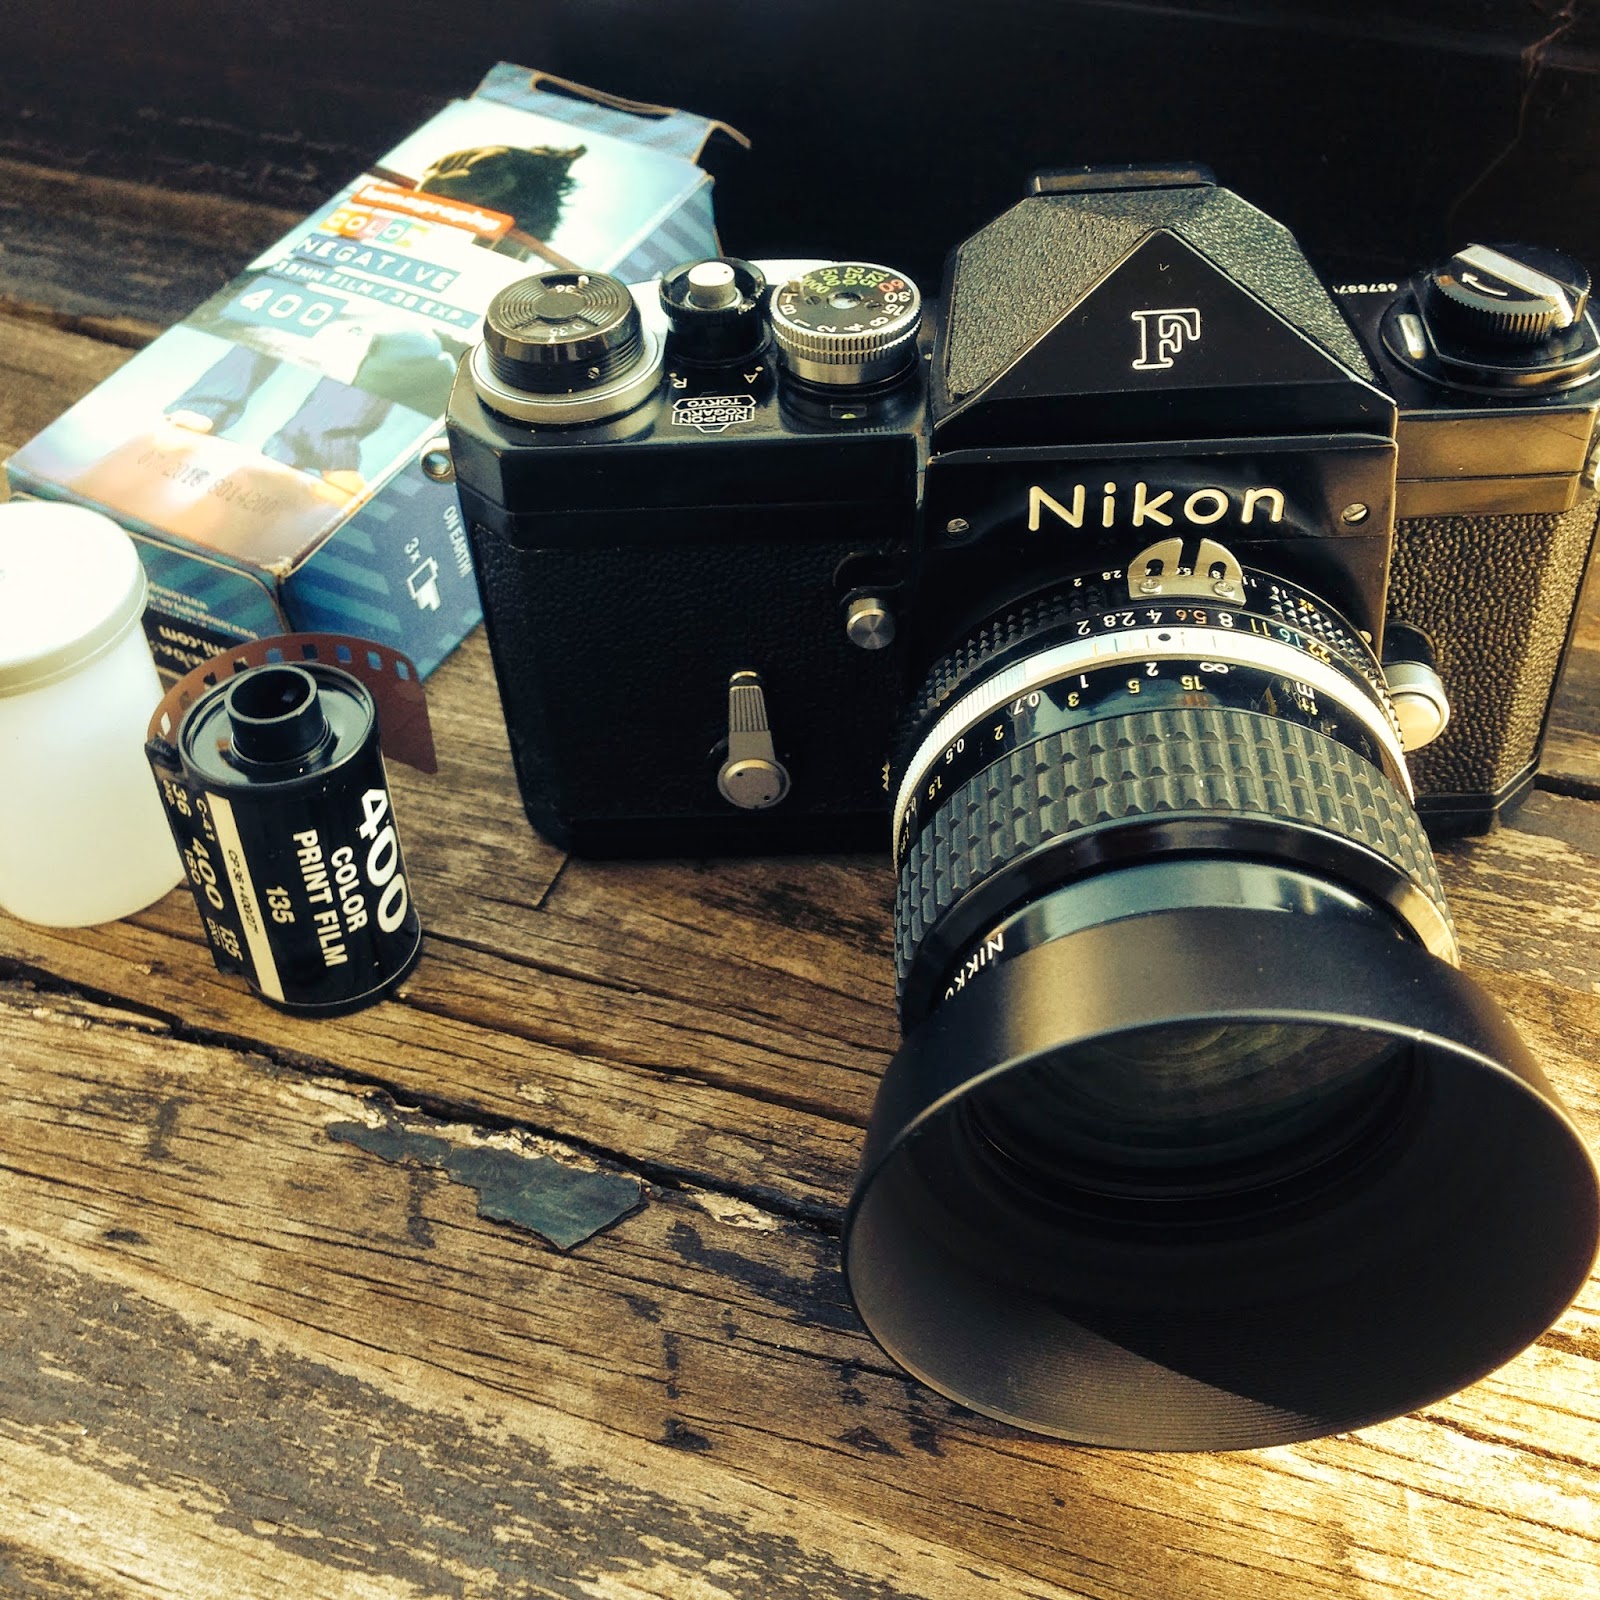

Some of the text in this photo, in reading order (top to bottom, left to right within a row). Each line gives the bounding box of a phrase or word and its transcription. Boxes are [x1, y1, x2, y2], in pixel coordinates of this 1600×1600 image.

[297, 238, 456, 291] NEGATIVE
[820, 269, 841, 287] 500
[842, 266, 865, 287] 250
[859, 270, 889, 288] 125
[327, 270, 374, 294] FILM
[879, 278, 905, 292] 60
[884, 291, 911, 303] 30
[240, 288, 334, 327] 400
[781, 304, 797, 315] B
[782, 292, 798, 304] T
[881, 303, 905, 316] 15
[816, 325, 837, 333] 2
[843, 323, 864, 332] 4
[870, 316, 889, 327] 8
[1131, 307, 1202, 371] F
[673, 378, 688, 389] R
[743, 372, 758, 384] A
[679, 408, 748, 418] KOGAKU
[687, 398, 742, 408] TOKYO
[679, 413, 748, 424] NIPPON
[1027, 481, 1286, 532] Nikon
[443, 505, 473, 577] ON EARTH
[1102, 569, 1122, 581] 2.8
[1270, 586, 1288, 599] 16
[1076, 608, 1331, 664] 2 2.8 4 5.6 8 11 16 22
[945, 738, 965, 764] 0.5
[1013, 692, 1040, 715] 0.7
[1079, 674, 1089, 689] 1
[1145, 661, 1158, 677] 2
[993, 724, 1005, 741] 2
[1067, 692, 1079, 707] 3
[1127, 678, 1141, 694] 5
[1180, 675, 1204, 691] 15
[172, 783, 192, 817] 36
[195, 798, 215, 841] C-41
[184, 848, 201, 885] ISO
[192, 836, 224, 910] 400
[356, 788, 408, 933] 400
[292, 828, 348, 968] PRINT FILM
[331, 845, 368, 933] COLOR
[265, 885, 295, 925] 135
[219, 924, 243, 961] 135
